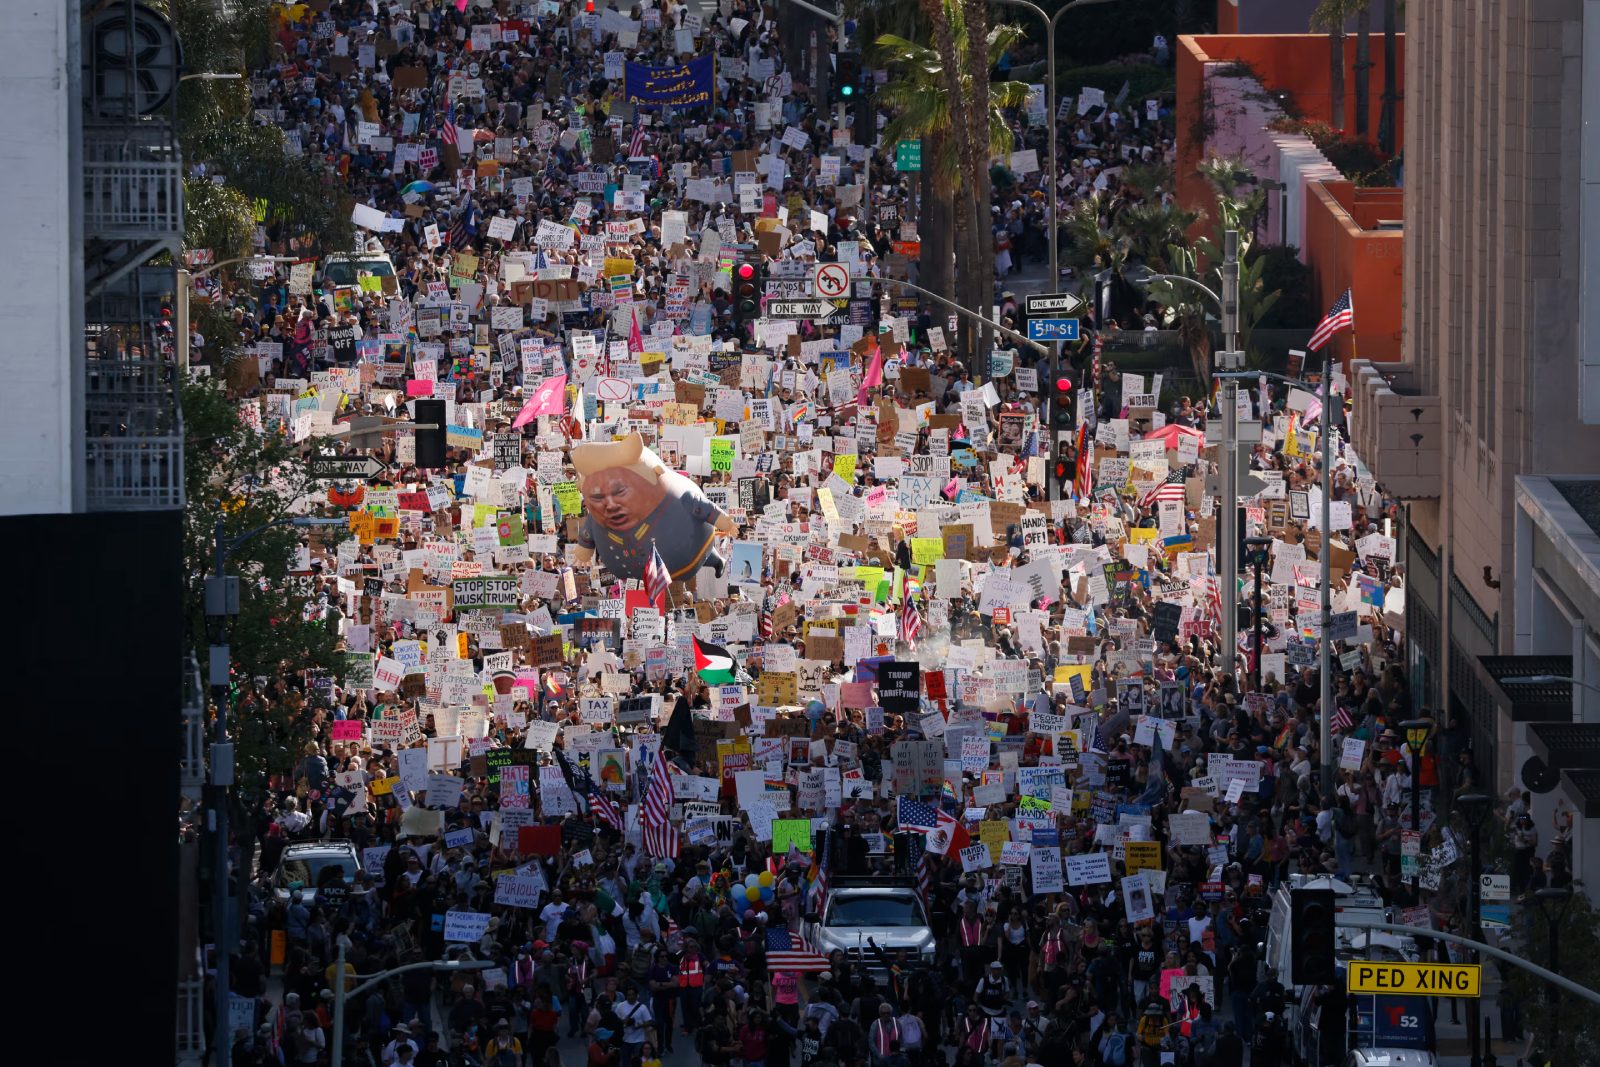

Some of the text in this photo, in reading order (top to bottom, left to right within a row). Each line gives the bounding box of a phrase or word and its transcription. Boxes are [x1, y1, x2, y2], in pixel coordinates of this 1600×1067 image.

[650, 66, 692, 80] UCLA
[768, 282, 798, 292] HANDS
[774, 304, 822, 314] ONE WAY
[330, 328, 354, 338] HANDS
[1035, 322, 1072, 337] 5th St
[334, 338, 351, 349] OFF
[494, 447, 519, 456] IS THE
[344, 462, 367, 472] WAY
[713, 461, 731, 471] YOU
[904, 478, 932, 490] TAX
[1022, 516, 1046, 528] HANDS
[1024, 532, 1047, 546] OFF!
[455, 580, 516, 592] STOP STOP
[454, 593, 516, 605] MUSK TRUMP
[598, 600, 624, 610] HANDS
[602, 610, 620, 618] OFF
[487, 655, 510, 666] HANDS
[490, 662, 508, 670] OFF!
[880, 690, 918, 698] TARIFFYING
[588, 700, 608, 710] TAX
[722, 696, 740, 705] FORK
[1034, 714, 1064, 722] PEOPLE
[372, 721, 403, 730] TARIFFS
[405, 725, 419, 734] THE
[1033, 723, 1063, 732] PROFIT
[405, 732, 421, 744] ARTS
[723, 754, 748, 766] HANDS
[1034, 774, 1065, 785] UNITED
[960, 844, 986, 856] HANDS
[968, 853, 984, 862] OFF!
[496, 882, 538, 896] FURIOUS
[514, 898, 536, 906] WORDS
[1360, 968, 1470, 990] PED XING
[1400, 1016, 1418, 1028] 52
